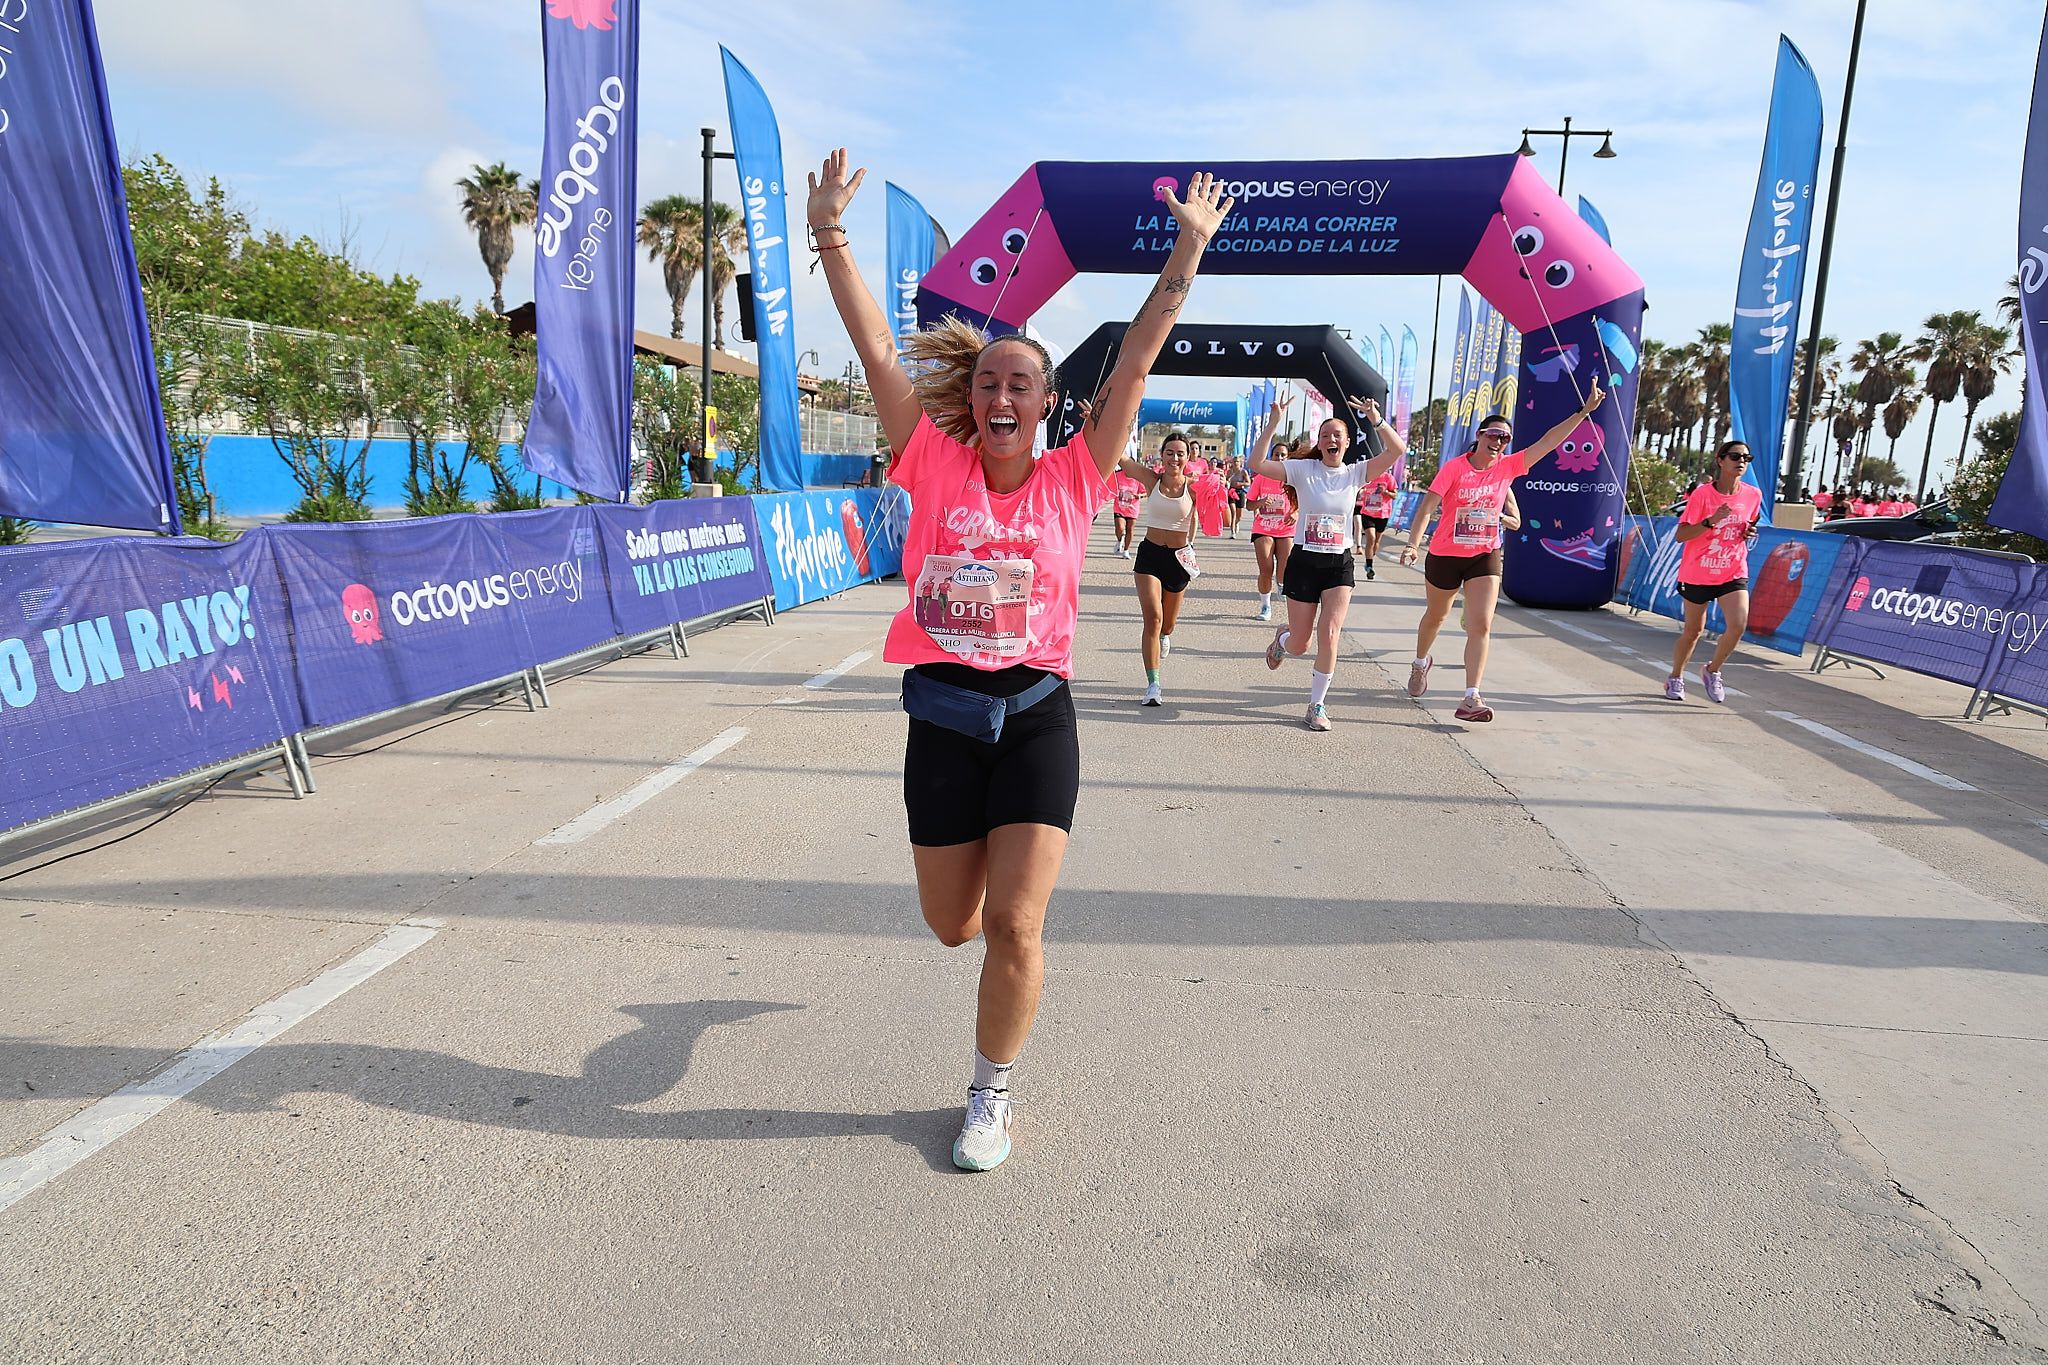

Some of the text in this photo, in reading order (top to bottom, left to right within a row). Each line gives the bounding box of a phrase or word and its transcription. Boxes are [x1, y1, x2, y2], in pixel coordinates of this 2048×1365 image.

[1298, 179, 1391, 205] energy
[1134, 212, 1398, 232] LA EGÍA PARA CORRER
[1132, 238, 1400, 253] A LA LOCIDAD DE LA LUZ
[1174, 340, 1294, 357] OLVO
[1169, 401, 1213, 419] Marlene
[1525, 479, 1619, 497] octopus energy
[1317, 531, 1334, 539] 016
[1467, 524, 1486, 532] 016
[626, 517, 747, 560] Solo unos metros más
[770, 499, 846, 604] Marlene
[632, 546, 755, 597] YA LO HAS CONSEGUIDO
[933, 564, 952, 573] SUMA
[1700, 556, 1731, 569] MUJER
[956, 571, 995, 583] ASTURIANA
[391, 558, 583, 626] octopus energy
[950, 601, 994, 619] 016
[962, 619, 982, 629] 2552
[1871, 587, 2048, 654] octopus energy
[925, 625, 950, 634] CARRERA
[951, 627, 959, 635] DE
[968, 629, 986, 638] MUJER
[990, 631, 1016, 639] VALENCIA
[0, 584, 256, 712] O UN RAYO!
[981, 643, 1015, 652] Santander
